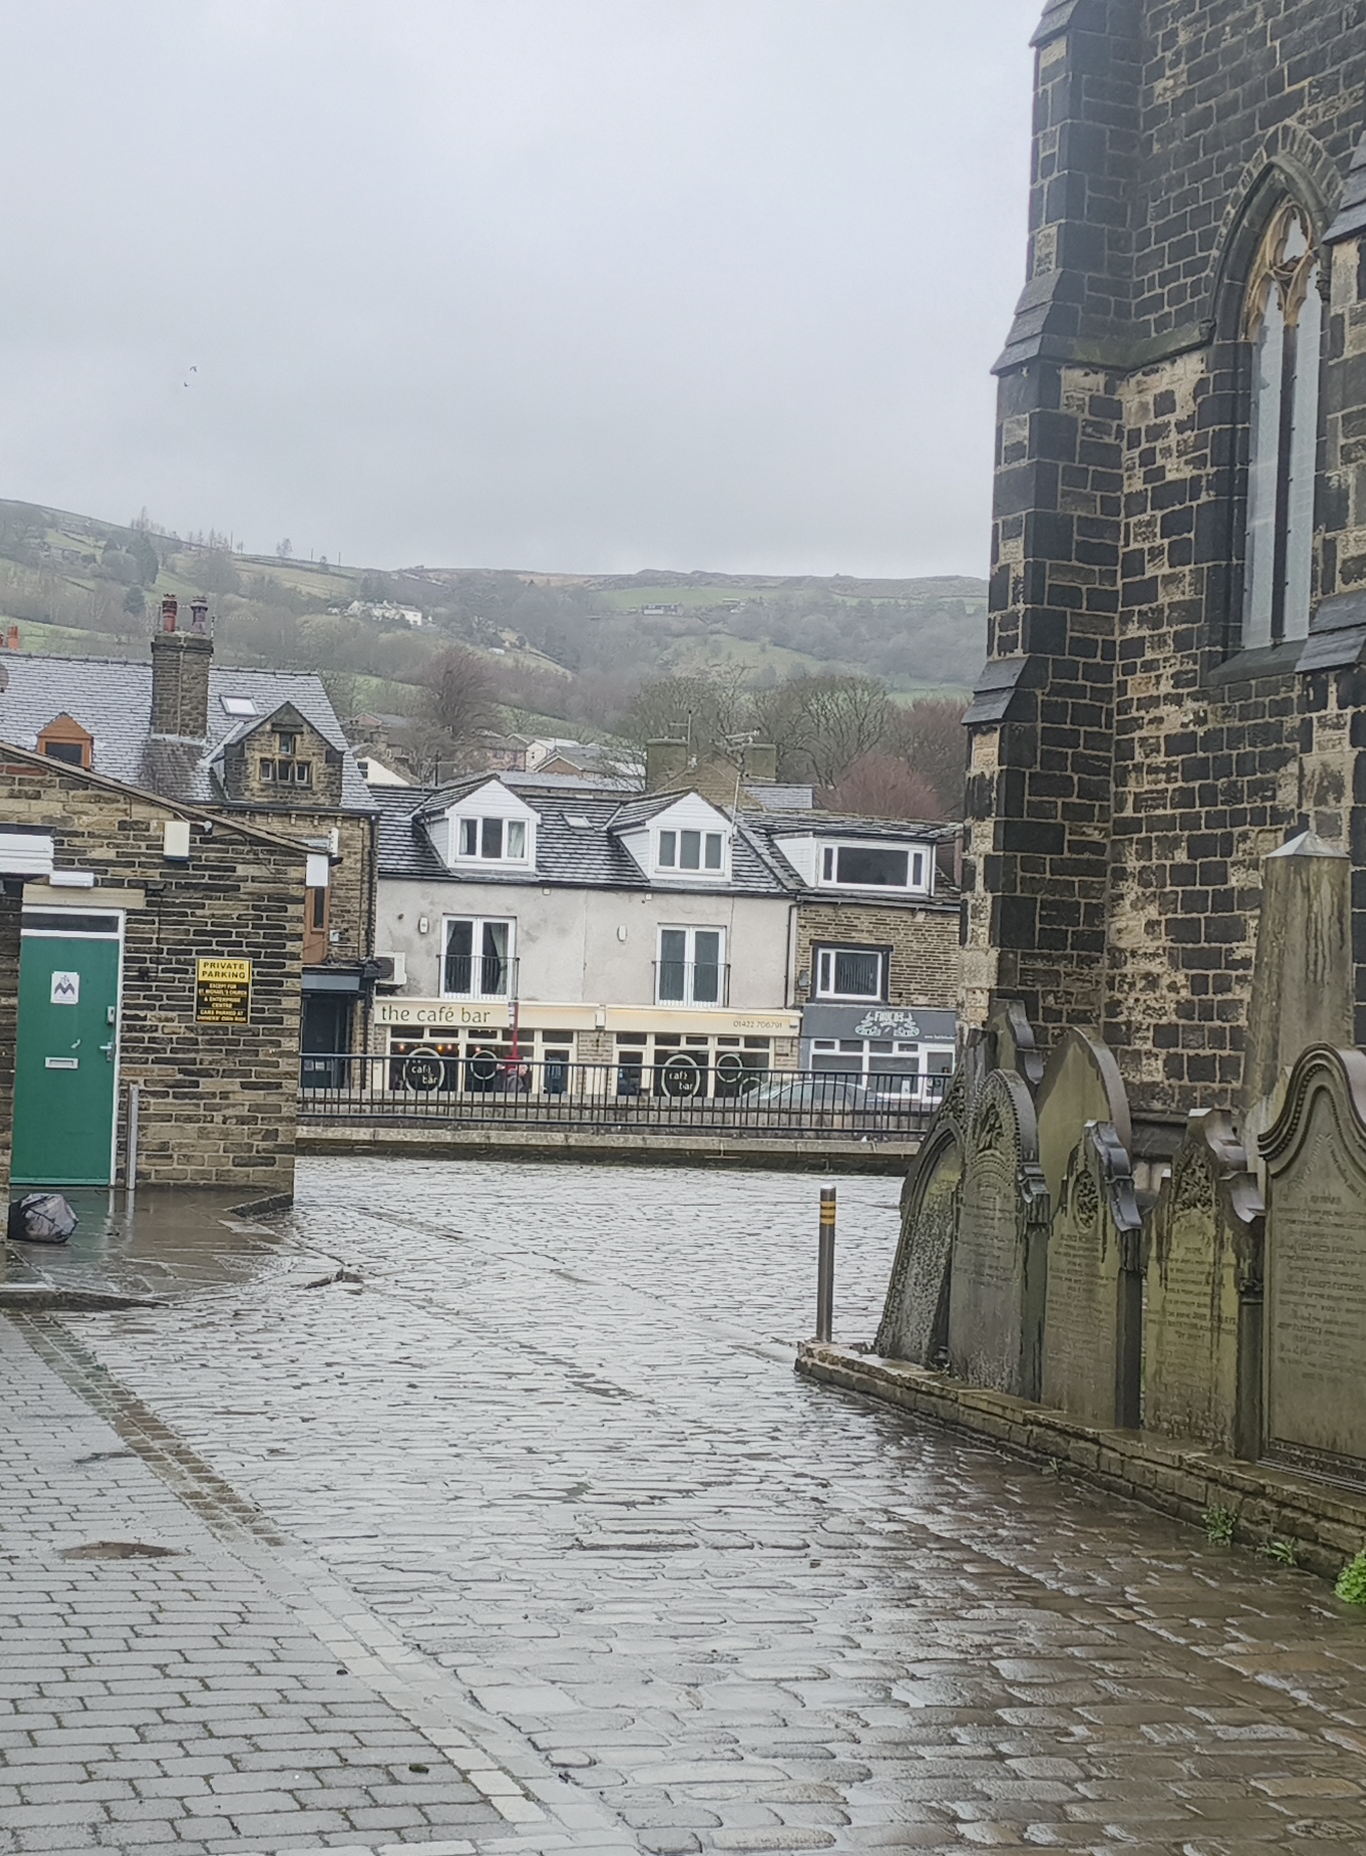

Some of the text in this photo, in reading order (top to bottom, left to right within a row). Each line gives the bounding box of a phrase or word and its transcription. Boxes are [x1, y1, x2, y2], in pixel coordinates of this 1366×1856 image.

[204, 962, 245, 970] PRIVATE
[202, 971, 246, 979] PARKING
[382, 1005, 410, 1021] the
[417, 1006, 454, 1022] café
[461, 1007, 491, 1023] bar
